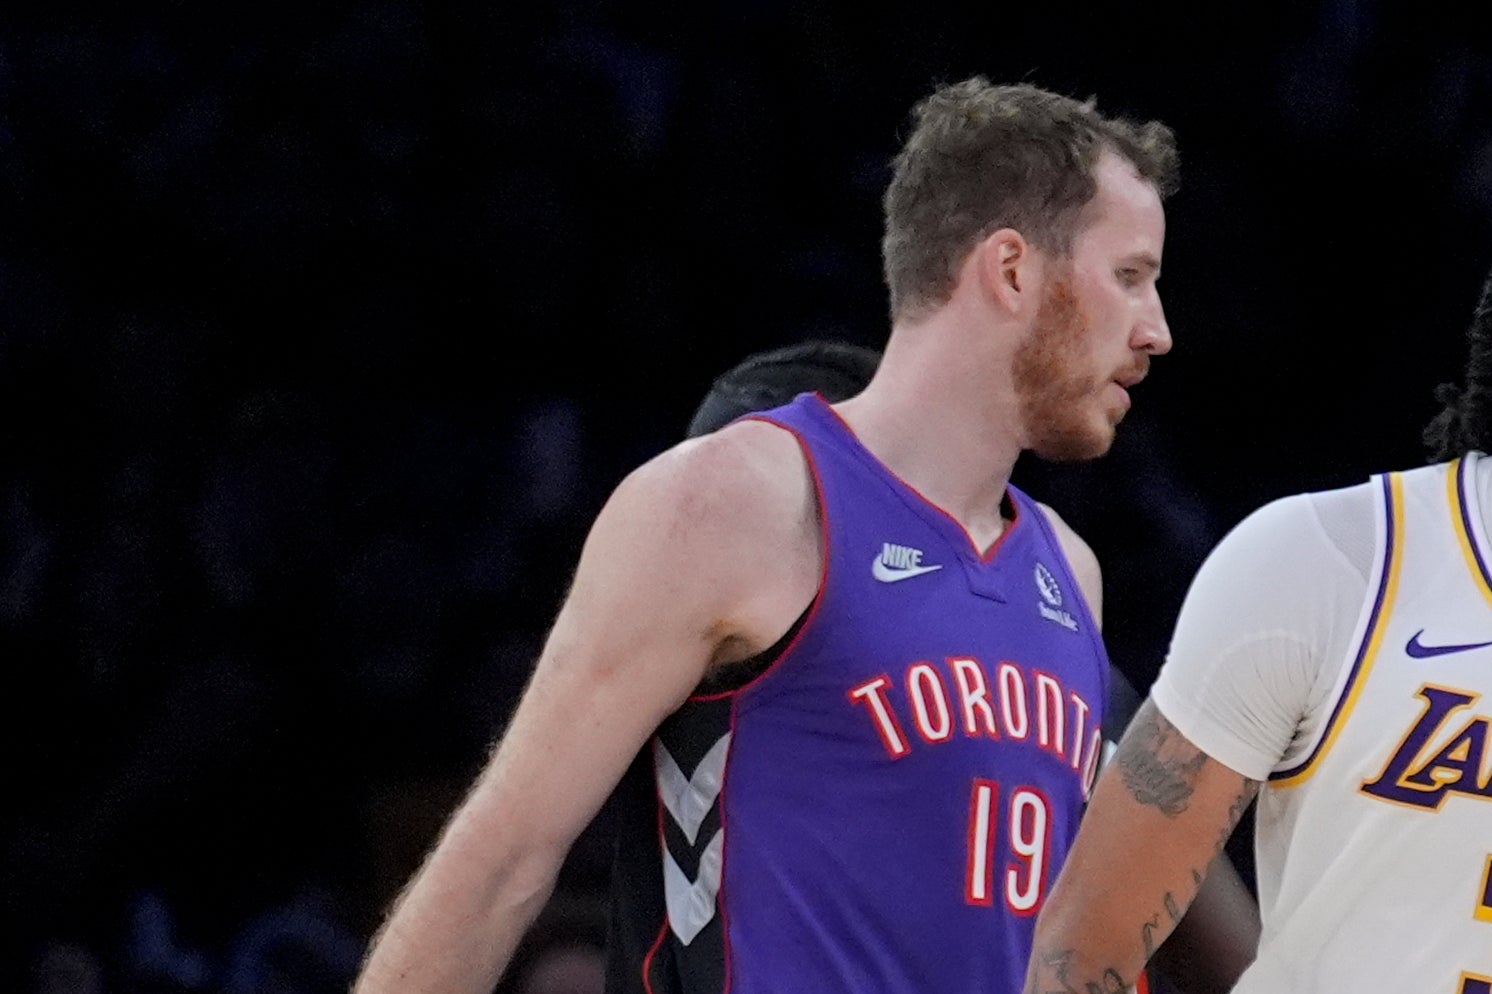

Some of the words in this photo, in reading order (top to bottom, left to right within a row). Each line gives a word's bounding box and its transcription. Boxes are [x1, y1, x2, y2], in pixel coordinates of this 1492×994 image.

[882, 542, 924, 571] NIKE
[849, 656, 1102, 800] TORONTO
[965, 773, 1053, 917] 19
